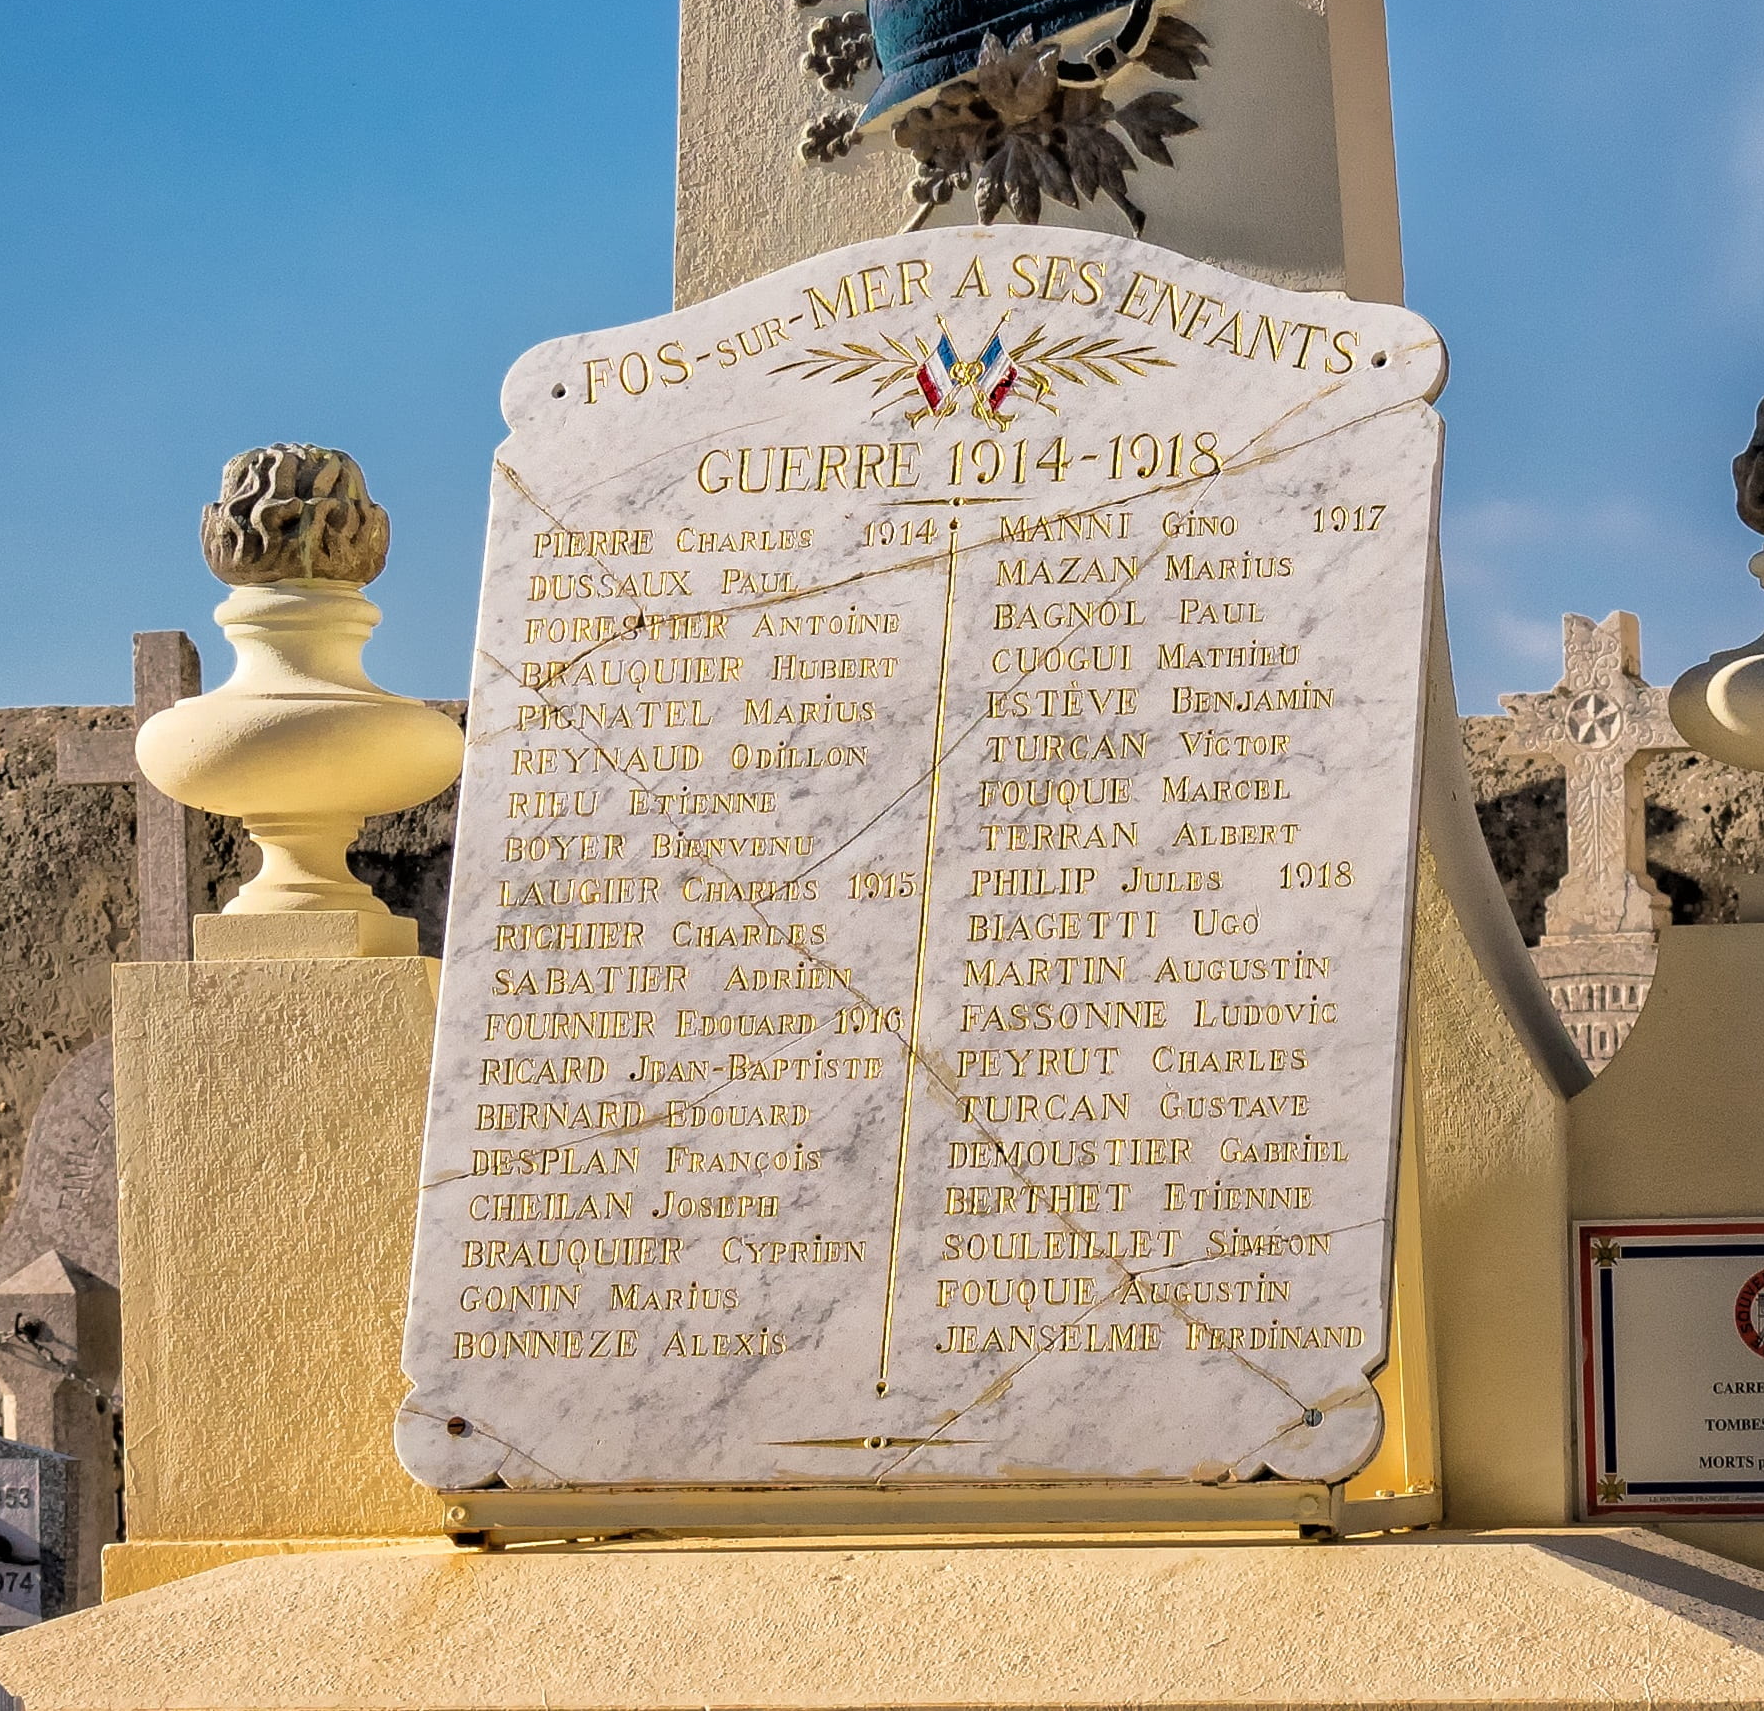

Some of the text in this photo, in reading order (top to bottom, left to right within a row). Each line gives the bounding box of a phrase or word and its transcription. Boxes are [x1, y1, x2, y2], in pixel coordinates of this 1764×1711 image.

[951, 255, 991, 298] A
[1008, 253, 1107, 306] SES
[1115, 271, 1361, 374] ENFANTS
[697, 431, 1227, 494] GUERRE 1914-1918
[533, 529, 654, 558] PIERRE
[861, 519, 937, 547] 1914
[999, 513, 1132, 542] MANNI
[1313, 505, 1388, 533] 1917
[527, 570, 692, 601] DUSSAUX
[996, 557, 1139, 586] MAZAN
[524, 612, 728, 644] FORESTIER
[993, 601, 1147, 630] BAGNOL
[992, 645, 1132, 673] CUOGUI
[519, 657, 744, 693] BRAUQUIER
[987, 682, 1139, 718] ESTÈVE
[516, 701, 714, 731] PIGNATEL
[511, 745, 704, 776] REYNAUD
[986, 733, 1148, 763] TURCAN
[508, 791, 599, 819] RIEU
[979, 778, 1132, 813] FOUQUE
[501, 834, 626, 863] BOYER
[980, 822, 1138, 852] TERRAN
[496, 878, 661, 908] LAUGIER
[848, 873, 918, 900] 1915
[971, 868, 1098, 897] PHILIP
[1280, 861, 1356, 889] 1918
[492, 922, 646, 952] RICHIER
[967, 911, 1158, 941] BIAGETTI
[492, 965, 689, 997] SABATIER
[963, 957, 1127, 987] MARTIN
[1547, 983, 1650, 1012] AMILL
[484, 1011, 657, 1042] FOURNIER
[835, 1008, 905, 1034] 1916
[960, 1001, 1168, 1033] FASSONNE
[479, 1056, 608, 1086] RICARD
[956, 1047, 1120, 1078] PEYRUT
[475, 1101, 644, 1131] BERNARD
[958, 1093, 1131, 1123] TURCAN
[472, 1147, 639, 1176] DESPLAN
[947, 1138, 1193, 1169] DEMOUSTIER
[469, 1192, 632, 1221] CHEILAN
[943, 1184, 1132, 1215] BERTHET
[462, 1238, 685, 1275] BRAUQUIER
[942, 1230, 1182, 1260] SOULEILLET
[460, 1284, 581, 1313] GONIN
[936, 1278, 1096, 1311] FOUQUE
[453, 1330, 639, 1360] BONNEZE
[935, 1324, 1162, 1353] JEANSELME
[1700, 1455, 1754, 1468] MORTS
